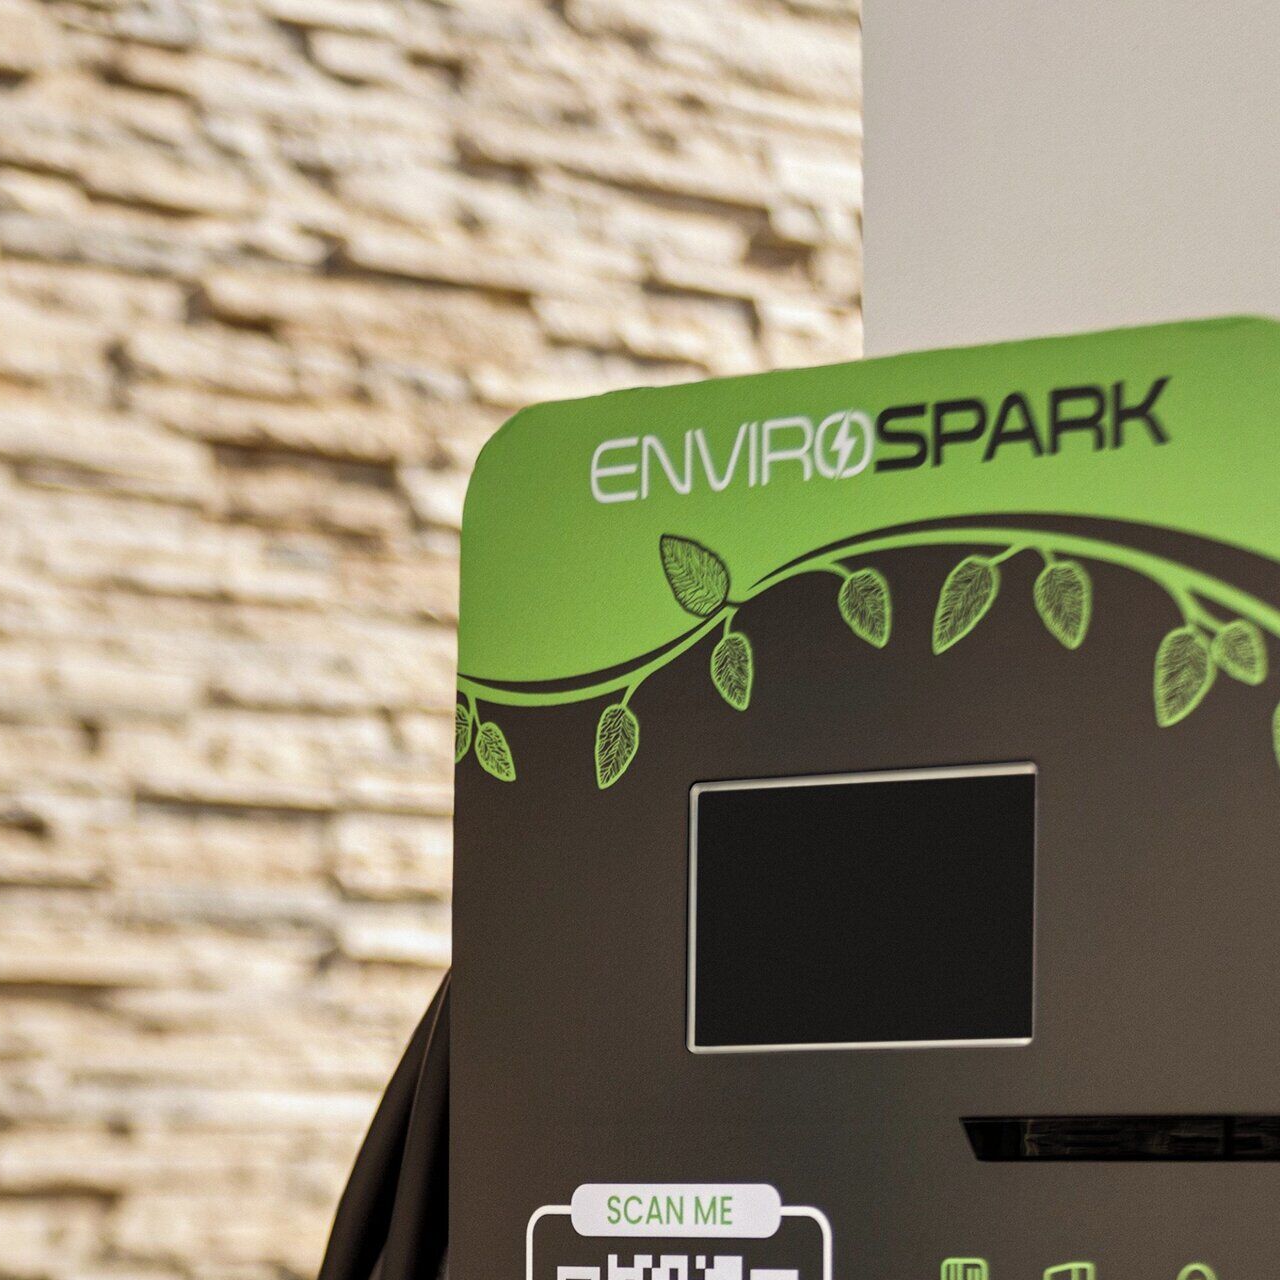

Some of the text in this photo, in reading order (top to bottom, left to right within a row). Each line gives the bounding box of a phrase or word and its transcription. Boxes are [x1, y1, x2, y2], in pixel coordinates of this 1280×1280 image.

[590, 375, 1173, 504] ENVIROSPARK
[606, 1195, 733, 1226] SCAN ME
